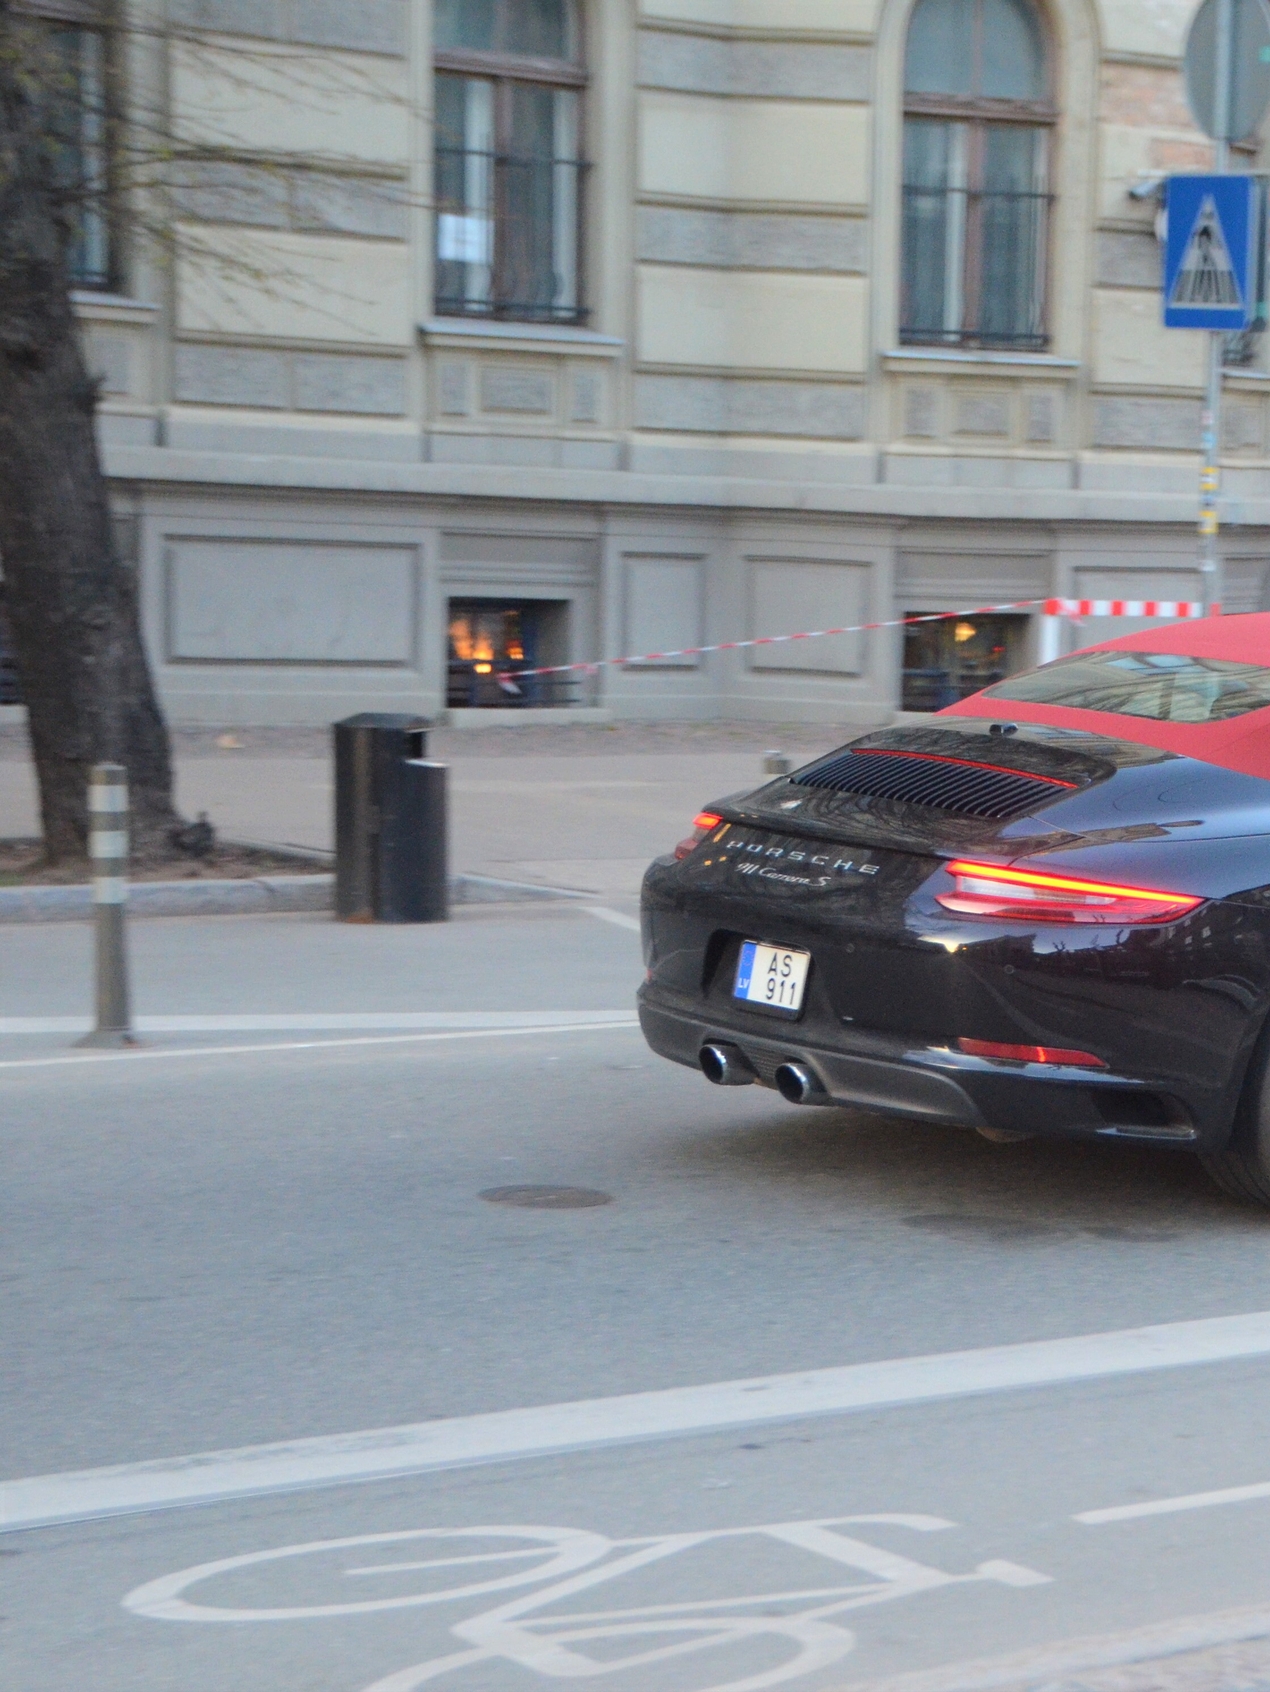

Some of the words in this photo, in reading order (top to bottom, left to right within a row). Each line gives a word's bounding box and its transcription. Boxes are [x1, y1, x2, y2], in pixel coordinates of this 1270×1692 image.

[726, 840, 880, 875] PORSCHE
[735, 862, 760, 875] 911
[759, 867, 811, 885] Carrera
[767, 952, 793, 978] AS
[738, 977, 750, 989] LV
[766, 977, 796, 1006] 911
